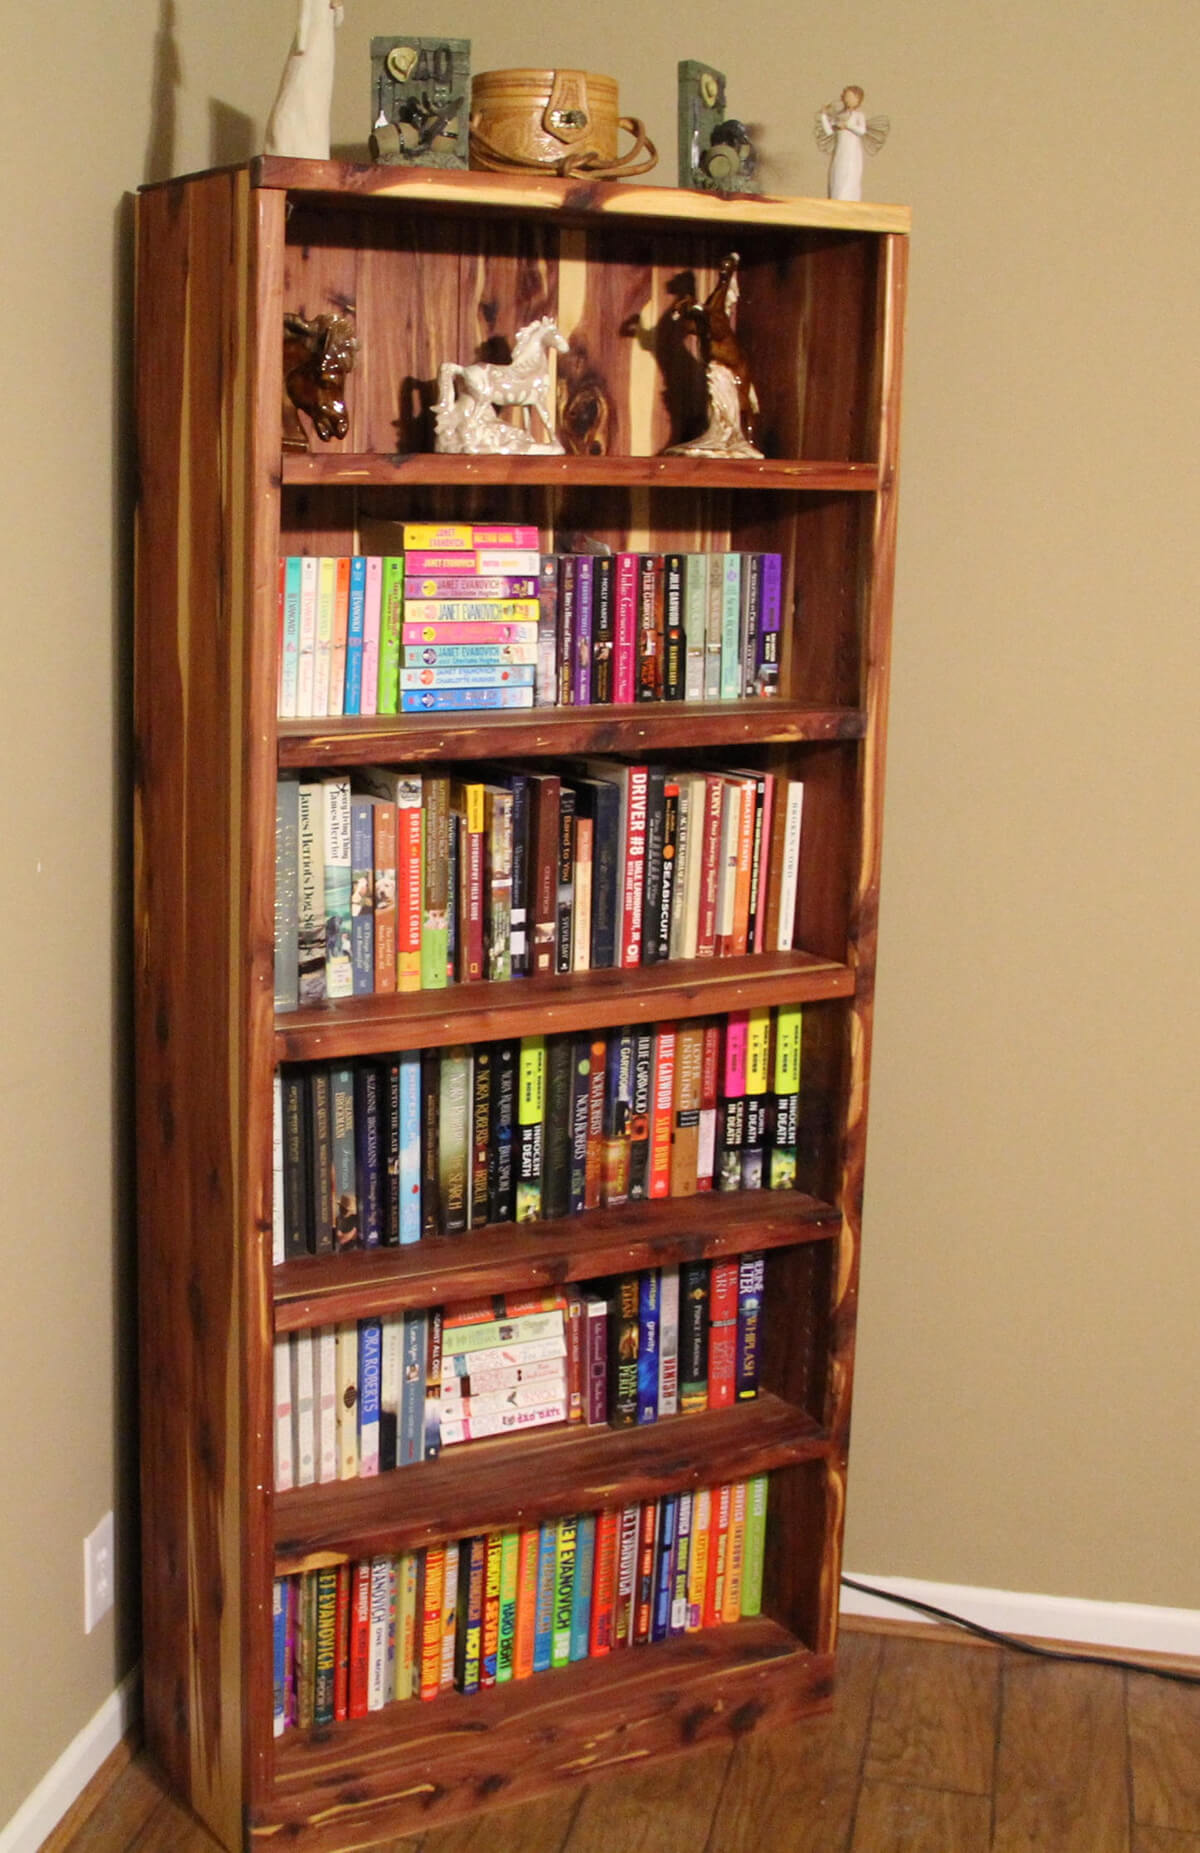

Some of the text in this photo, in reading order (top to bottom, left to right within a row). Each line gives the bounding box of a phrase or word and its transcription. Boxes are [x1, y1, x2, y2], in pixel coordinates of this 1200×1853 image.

[438, 580, 499, 589] JANET EVANOVICH
[619, 568, 632, 646] Julie Garwood
[642, 571, 652, 630] JULIE GARWOOD
[669, 572, 680, 626] JULIE GARWOOD
[352, 597, 363, 632] EVANOVICH
[437, 604, 503, 620] JANET EVANOVICH
[439, 647, 499, 656] JANET EVANOVICH
[330, 791, 340, 859] James Herriot
[340, 811, 350, 836] Living
[630, 773, 647, 856] DRIVER #8
[711, 783, 721, 818] TONY
[299, 792, 315, 912] James Herriot's Dog
[563, 815, 571, 846] Bared
[741, 792, 752, 871] DISASTER STATUS
[409, 813, 420, 945] HORSE DIFFERENT COLOR
[543, 865, 551, 914] COLLECTION
[634, 860, 643, 881] DALE
[660, 862, 672, 940] SEABISCUIT
[561, 916, 569, 942] SYLVIA
[476, 1070, 490, 1100] NORA
[681, 1037, 693, 1109] ENSHRINED
[692, 1043, 701, 1080] LOVER
[316, 1078, 327, 1139] JULIA QUINN
[576, 1094, 588, 1122] NORA
[591, 1072, 605, 1135] NORA ROBERTS
[635, 1061, 649, 1113] GARWOOD
[654, 1034, 675, 1171] JULIE GARWOOD SLOW BURN
[367, 1074, 377, 1168] SUZANNE BROCKMANN
[475, 1103, 490, 1146] ROBERTS
[574, 1122, 588, 1160] ROBERTS
[726, 1116, 735, 1144] DEATH
[734, 1101, 743, 1144] CREATION
[748, 1101, 757, 1143] IN DEATH
[777, 1099, 787, 1144] IN DEATH
[788, 1095, 798, 1144] INNOCENT
[522, 1129, 532, 1177] IN DEATH
[532, 1125, 542, 1177] INNOCENT
[448, 1174, 463, 1210] SEARCH
[432, 1345, 440, 1358] ALL
[646, 1321, 656, 1353] gravity
[743, 1314, 757, 1376] WHIPLASH
[363, 1358, 378, 1412] ROBERTS
[662, 1358, 676, 1398] VANISH
[618, 1530, 635, 1596] EVANOVICH
[359, 1582, 368, 1623] EVANOVICH
[372, 1563, 389, 1624] EVANOVICH
[484, 1547, 501, 1676] EVANOVICH SEVEN UP
[556, 1550, 575, 1629] EVANOVICH
[318, 1593, 337, 1670] EVANOVICH
[500, 1602, 515, 1669] HARD EIGHT
